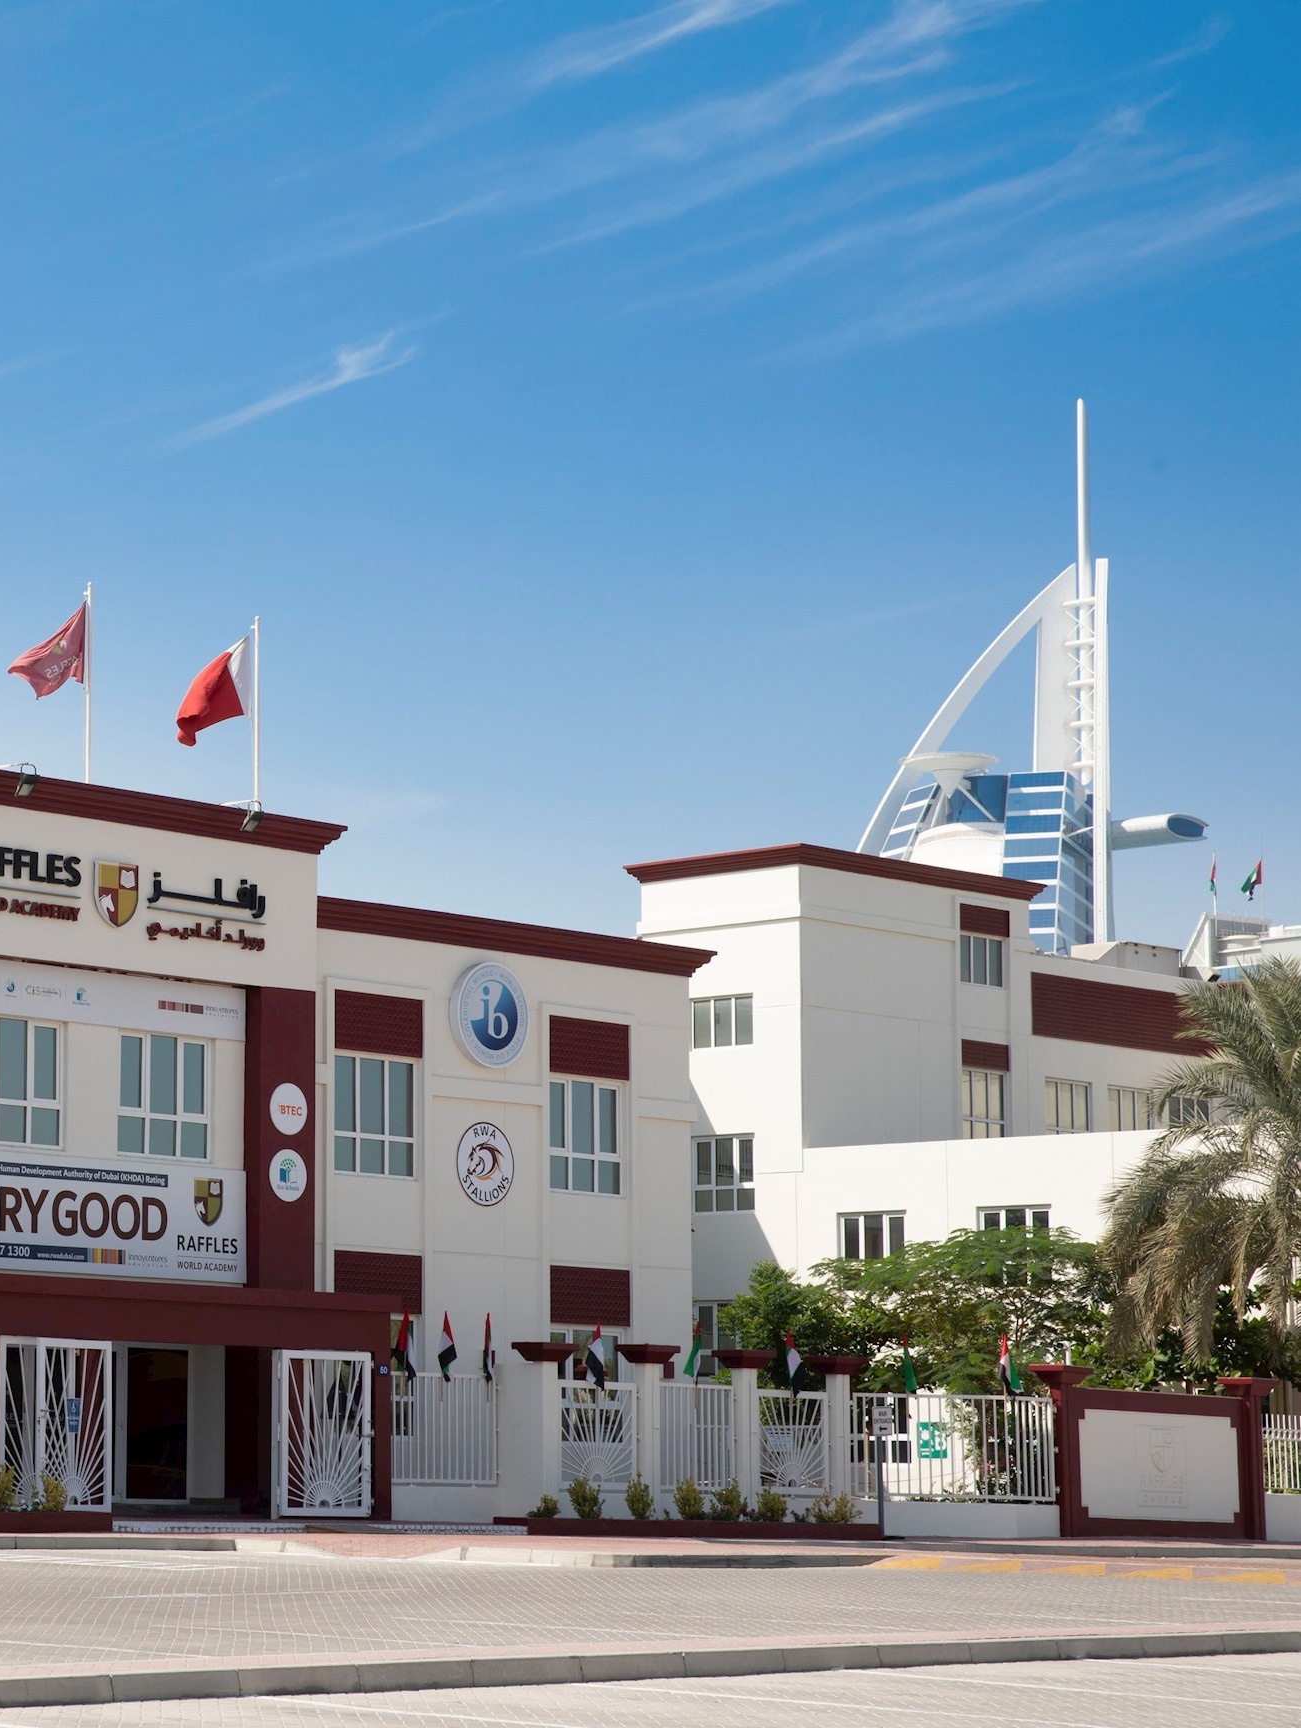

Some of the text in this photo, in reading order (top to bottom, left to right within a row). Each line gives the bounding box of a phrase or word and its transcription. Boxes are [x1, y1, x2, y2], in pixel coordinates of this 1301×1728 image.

[9, 899, 81, 922] ACADEMY
[472, 969, 494, 985] MUNDO
[499, 972, 518, 994] WORLD
[281, 1105, 303, 1116] BTEC
[473, 1125, 497, 1140] RWA
[21, 1166, 62, 1176] Development
[63, 1169, 93, 1180] Authority
[94, 1171, 101, 1179] of
[102, 1172, 119, 1181] Dubai
[120, 1174, 145, 1183] (KHDA)
[145, 1175, 166, 1187] Rating
[462, 1174, 510, 1202] STALLIONS
[51, 1189, 168, 1242] GOOD
[7, 1245, 31, 1257] 1300
[177, 1235, 238, 1255] RAFFLES
[36, 1251, 85, 1261] www.rwadubai.com
[176, 1260, 238, 1272] WORLD ACADEMY
[379, 1366, 388, 1374] 50
[1139, 1474, 1185, 1489] RAFFLES
